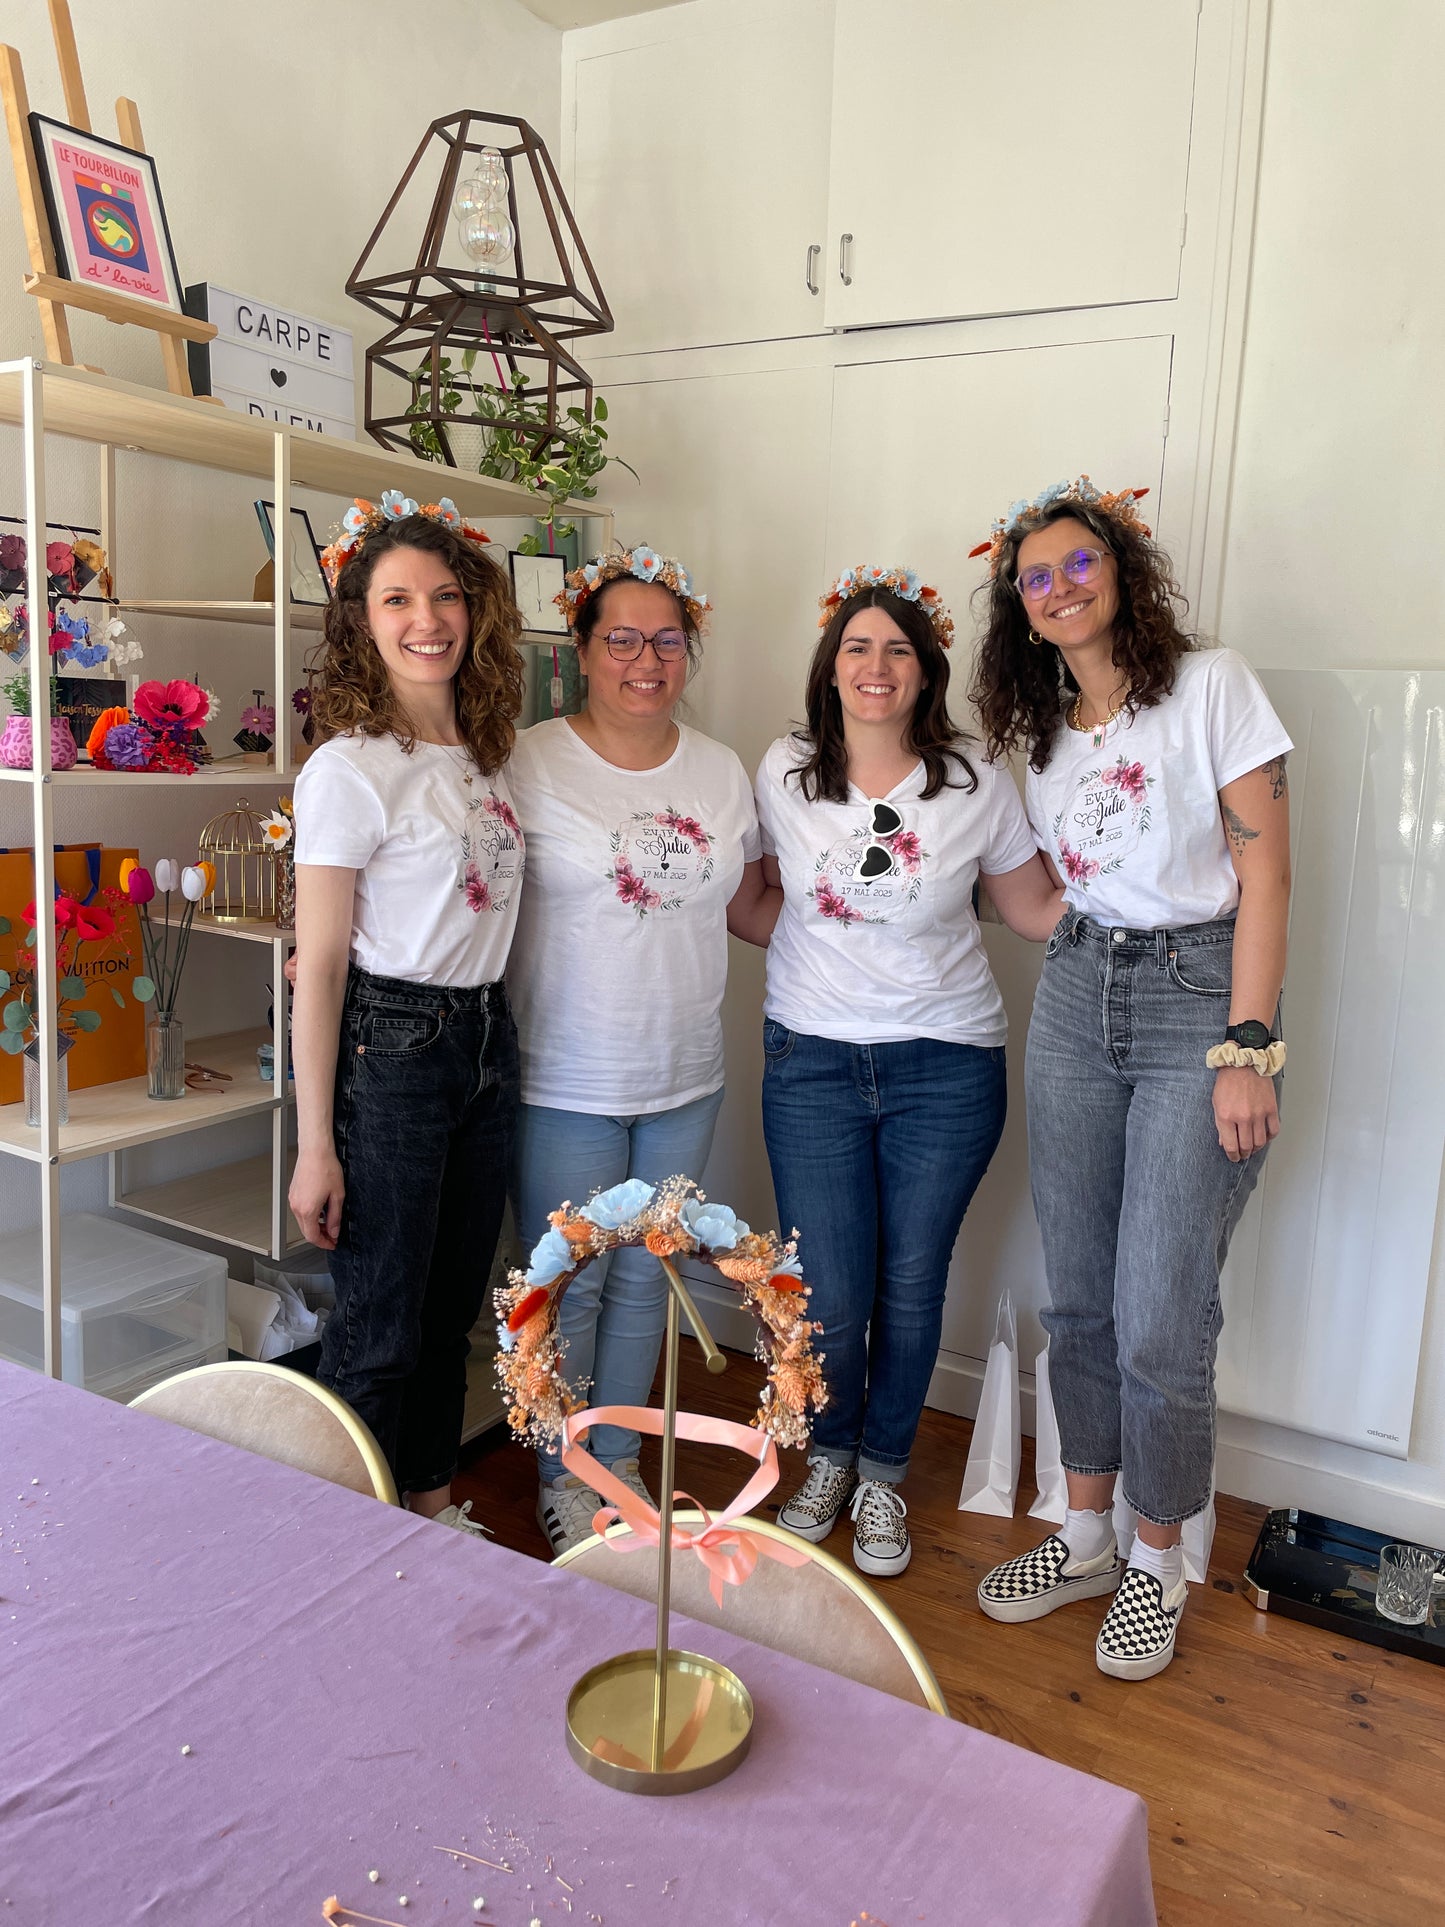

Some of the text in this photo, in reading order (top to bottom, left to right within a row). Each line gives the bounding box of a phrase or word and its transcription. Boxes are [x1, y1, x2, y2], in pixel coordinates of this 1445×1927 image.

[59, 147, 139, 188] LE TOURBILLON
[237, 305, 331, 361] CARPE
[1084, 787, 1118, 806] EVJF
[1095, 794, 1127, 829] Julie
[657, 836, 692, 862] Julie
[1078, 830, 1123, 851] 17 MAI 2025
[642, 870, 687, 880] 17 MAI 2025
[841, 886, 893, 898] 17 MAI 2025
[62, 957, 130, 978] VUITTON
[1366, 1429, 1400, 1442] atlantic
